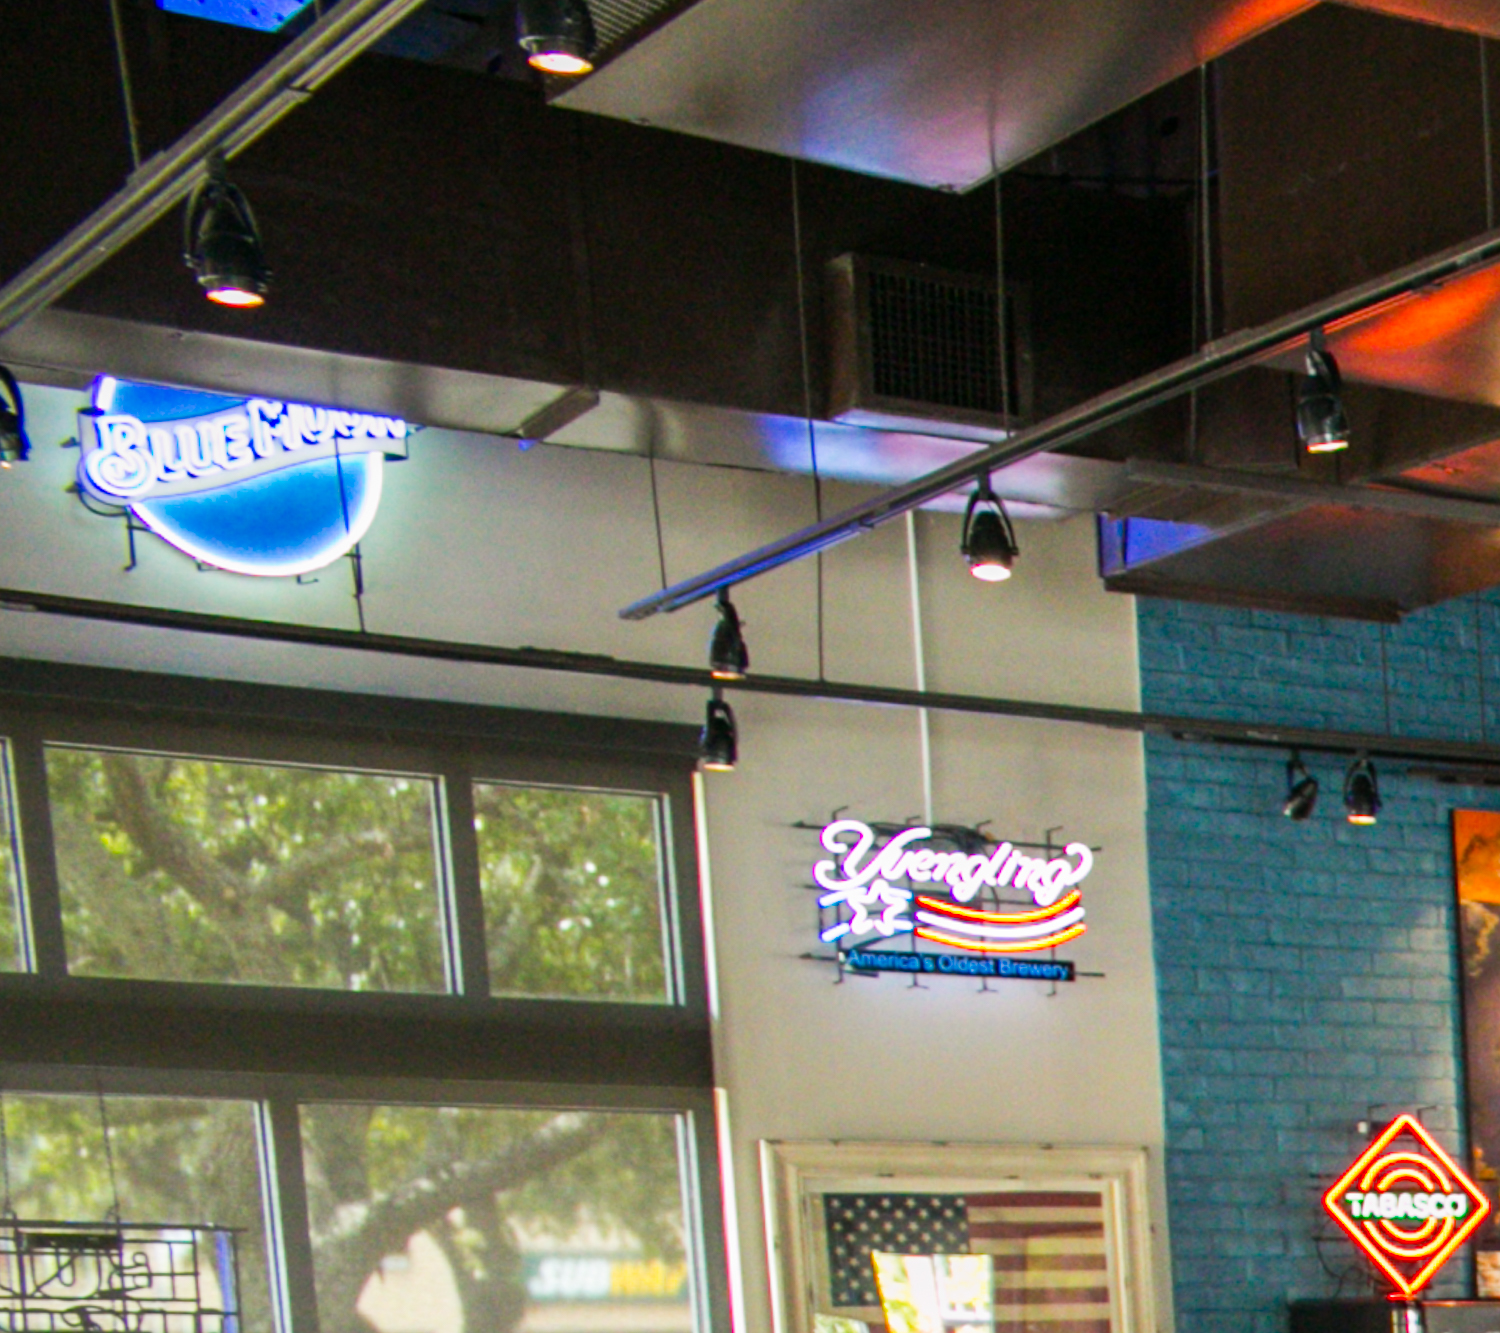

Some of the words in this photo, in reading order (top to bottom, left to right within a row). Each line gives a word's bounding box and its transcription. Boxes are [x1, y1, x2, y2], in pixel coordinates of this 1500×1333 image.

[813, 819, 1094, 907] Yuengling
[848, 950, 935, 972] America's
[937, 953, 995, 974] Oldest
[999, 958, 1071, 979] Brewery
[1345, 1190, 1468, 1221] TABASCO
